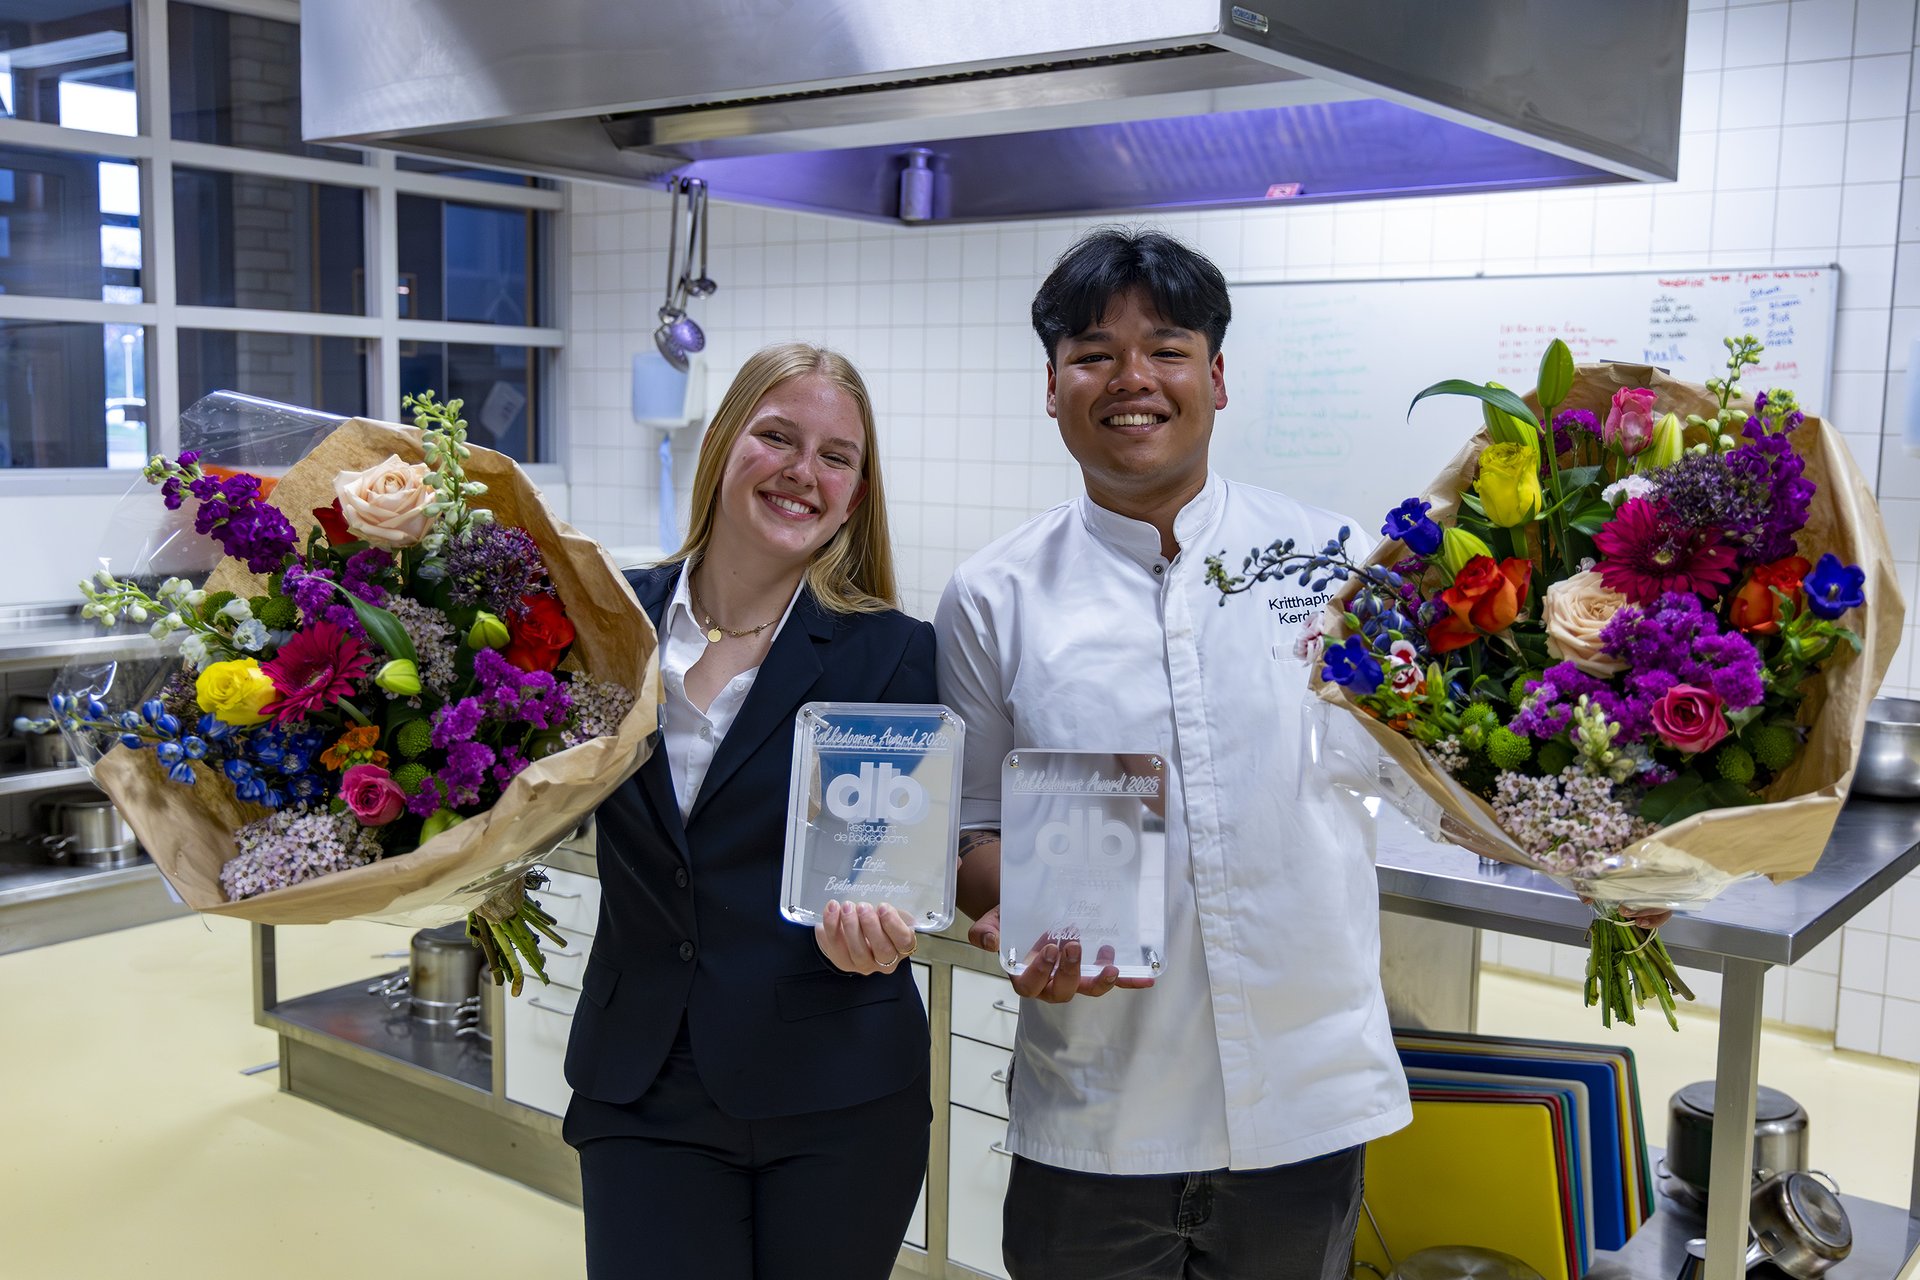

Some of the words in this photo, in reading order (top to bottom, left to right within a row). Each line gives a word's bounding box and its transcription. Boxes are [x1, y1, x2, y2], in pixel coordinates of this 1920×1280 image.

[879, 726, 916, 747] Award
[826, 762, 924, 823] db
[1087, 771, 1127, 793] Award
[1127, 775, 1160, 793] 2025
[834, 832, 847, 842] de
[847, 822, 897, 833] Restaurant
[1035, 806, 1136, 867] db
